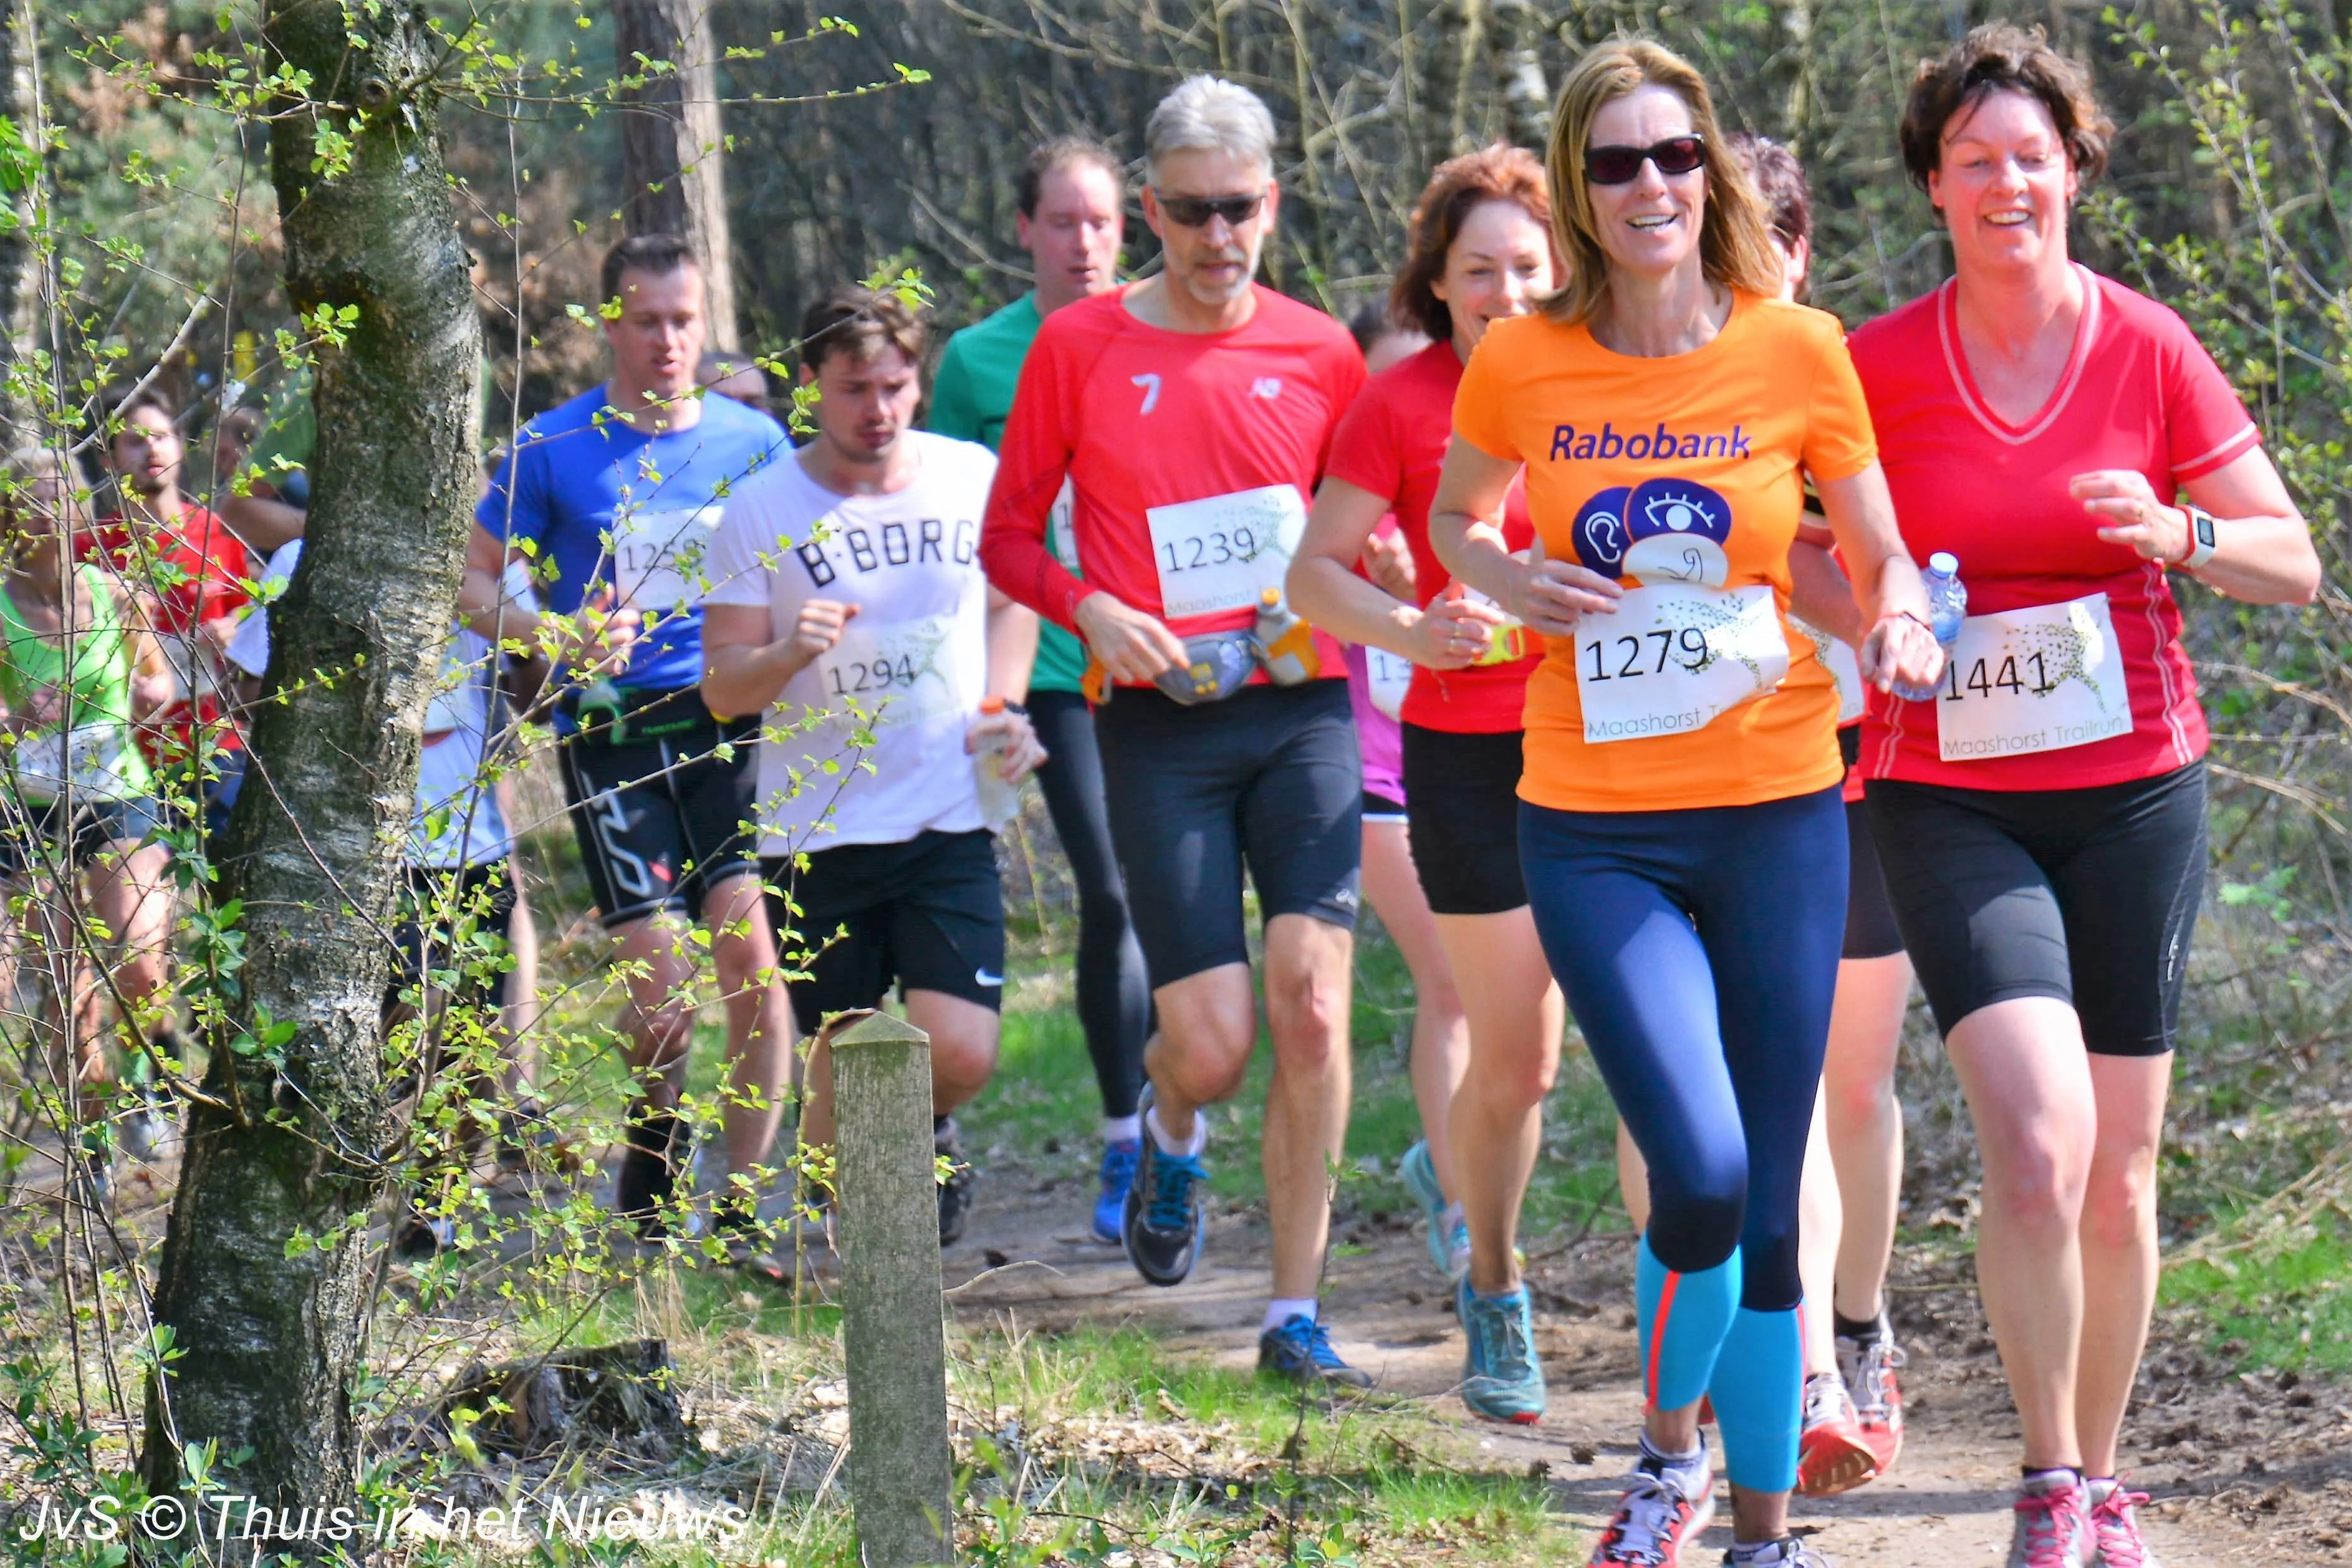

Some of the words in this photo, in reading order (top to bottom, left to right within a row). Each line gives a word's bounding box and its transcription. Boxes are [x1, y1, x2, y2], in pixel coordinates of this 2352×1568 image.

[1549, 422, 1752, 462] Rabobank
[1162, 526, 1257, 573] 1239
[828, 654, 916, 695] 1294
[1585, 627, 1708, 682] 1279
[1945, 651, 2055, 701] 1441
[1588, 707, 1701, 738] Maashorst
[1943, 728, 2048, 756] Maashorst
[2053, 715, 2123, 743] Trailrun
